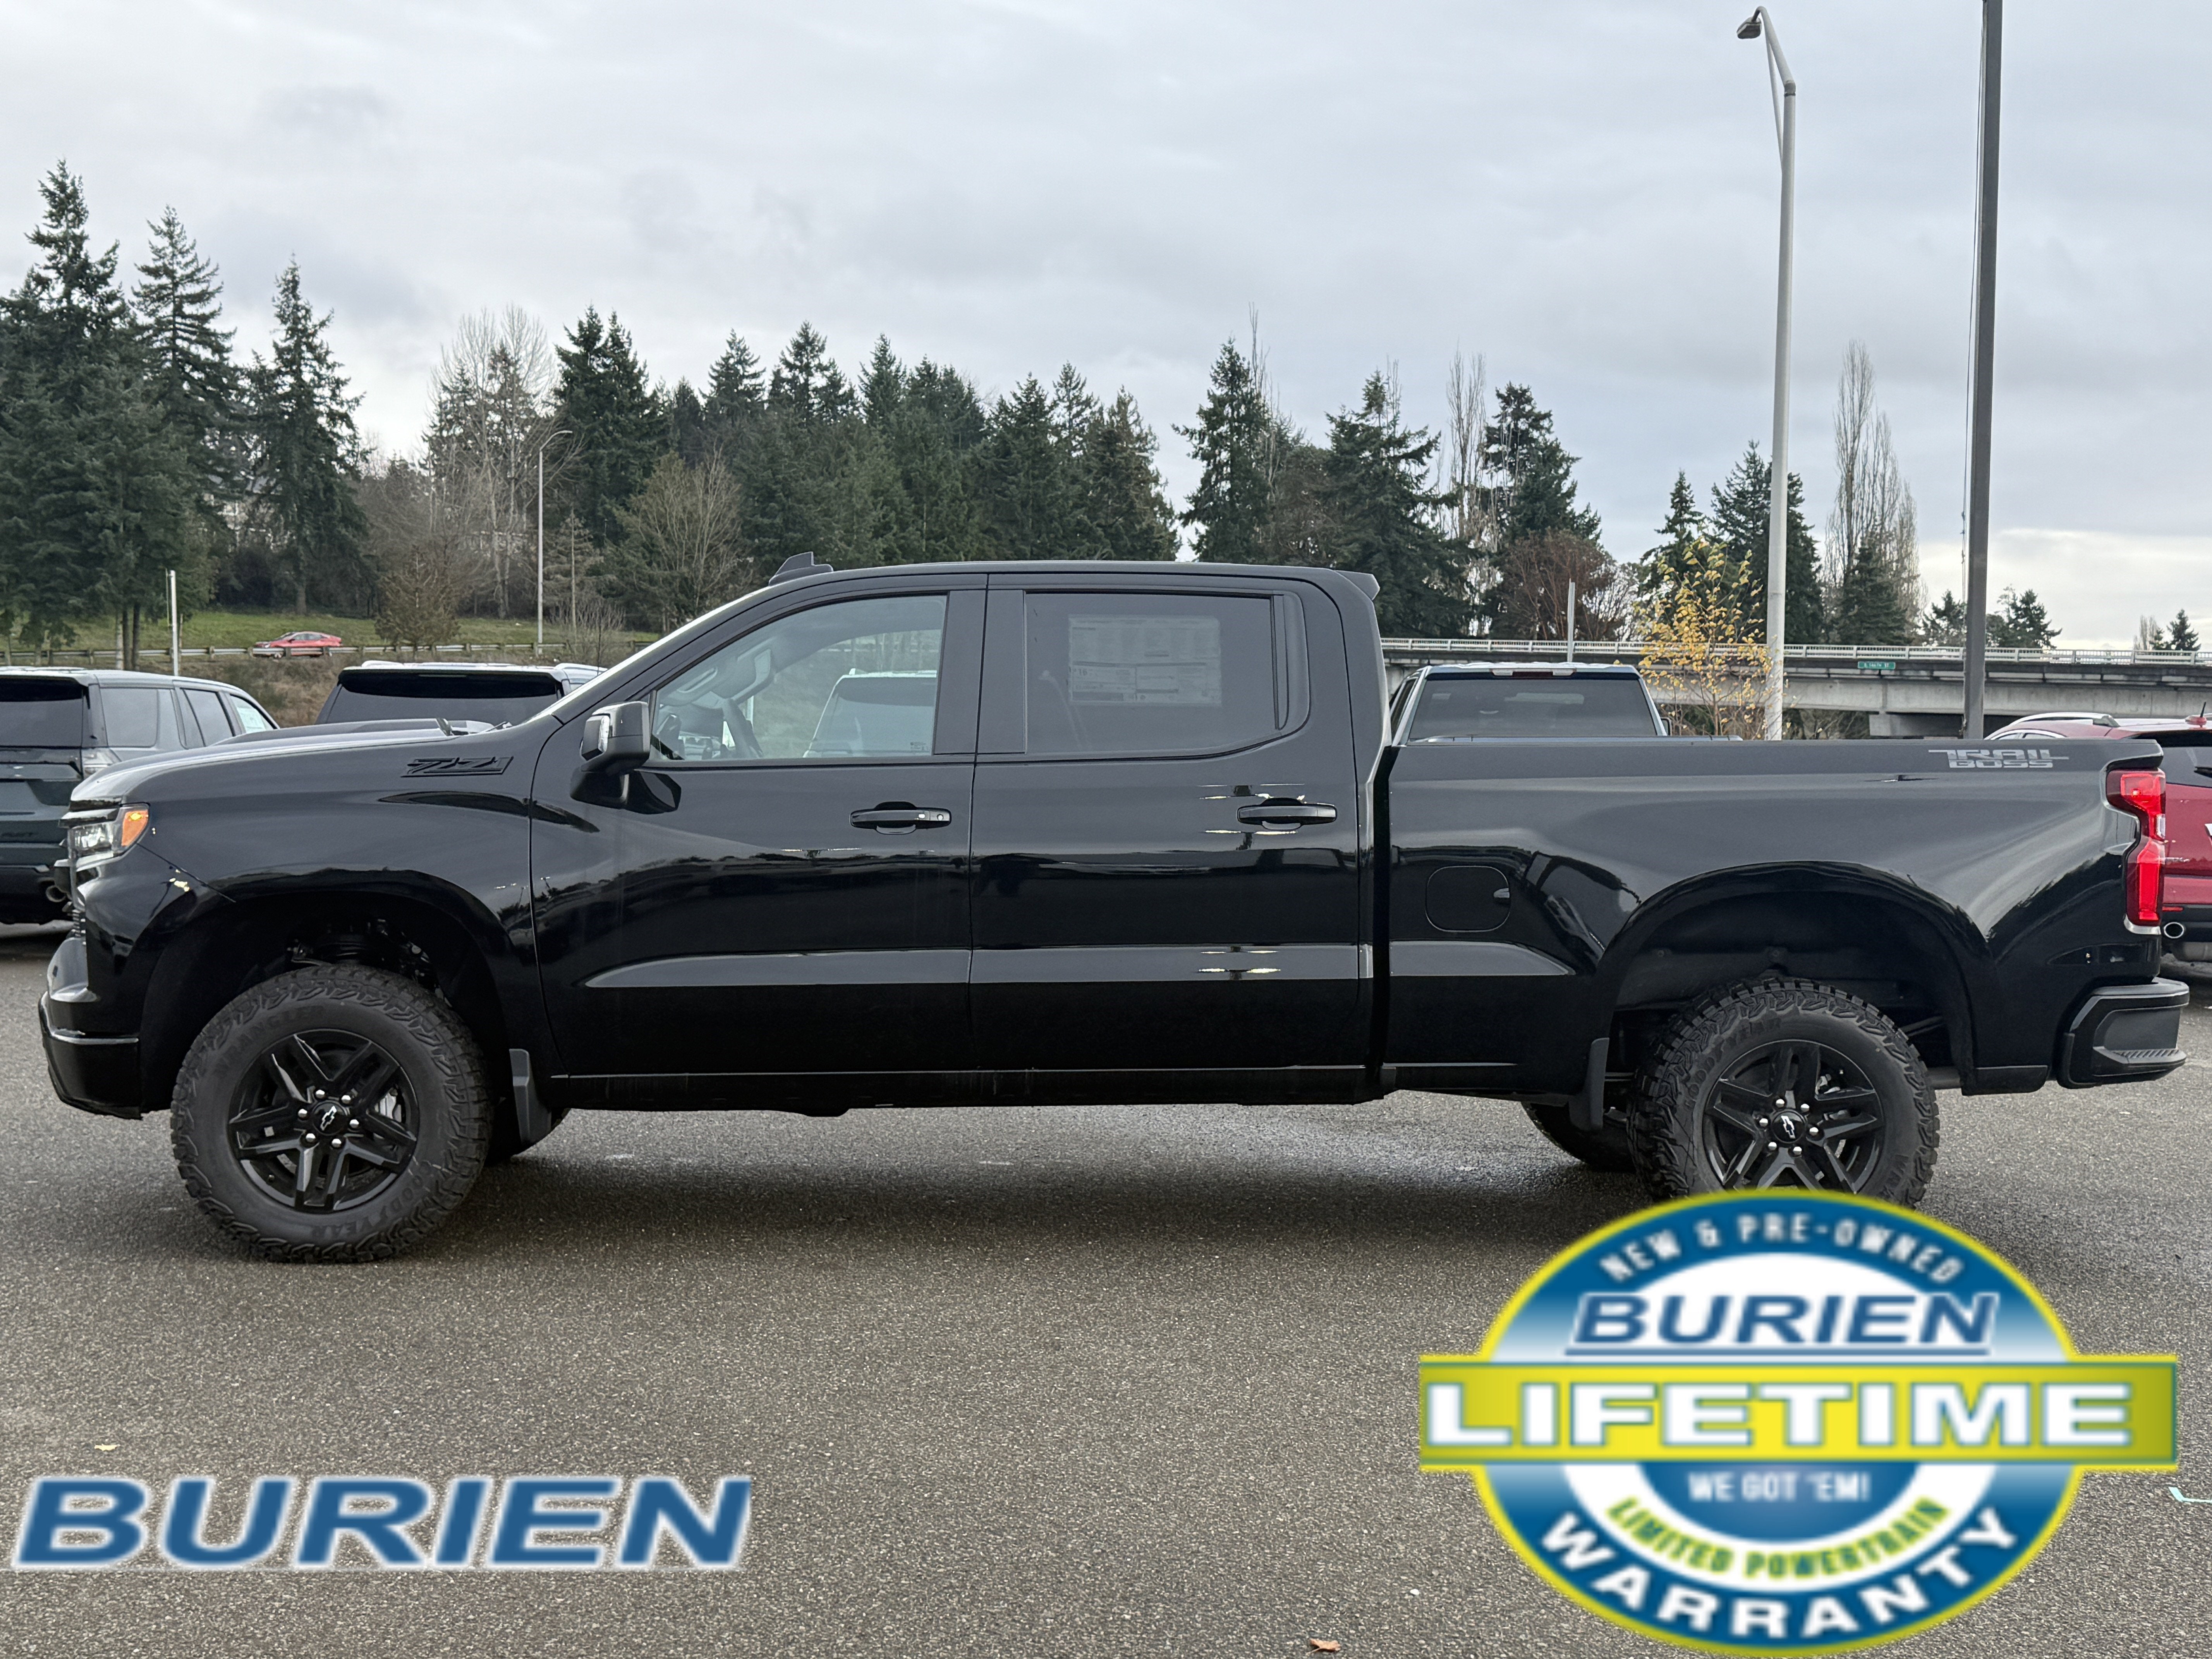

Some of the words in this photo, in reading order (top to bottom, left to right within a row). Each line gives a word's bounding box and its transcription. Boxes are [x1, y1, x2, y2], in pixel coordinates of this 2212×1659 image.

[1928, 750, 2069, 760] TRAIL
[406, 756, 513, 776] Z71
[1949, 760, 2053, 768] BOSS
